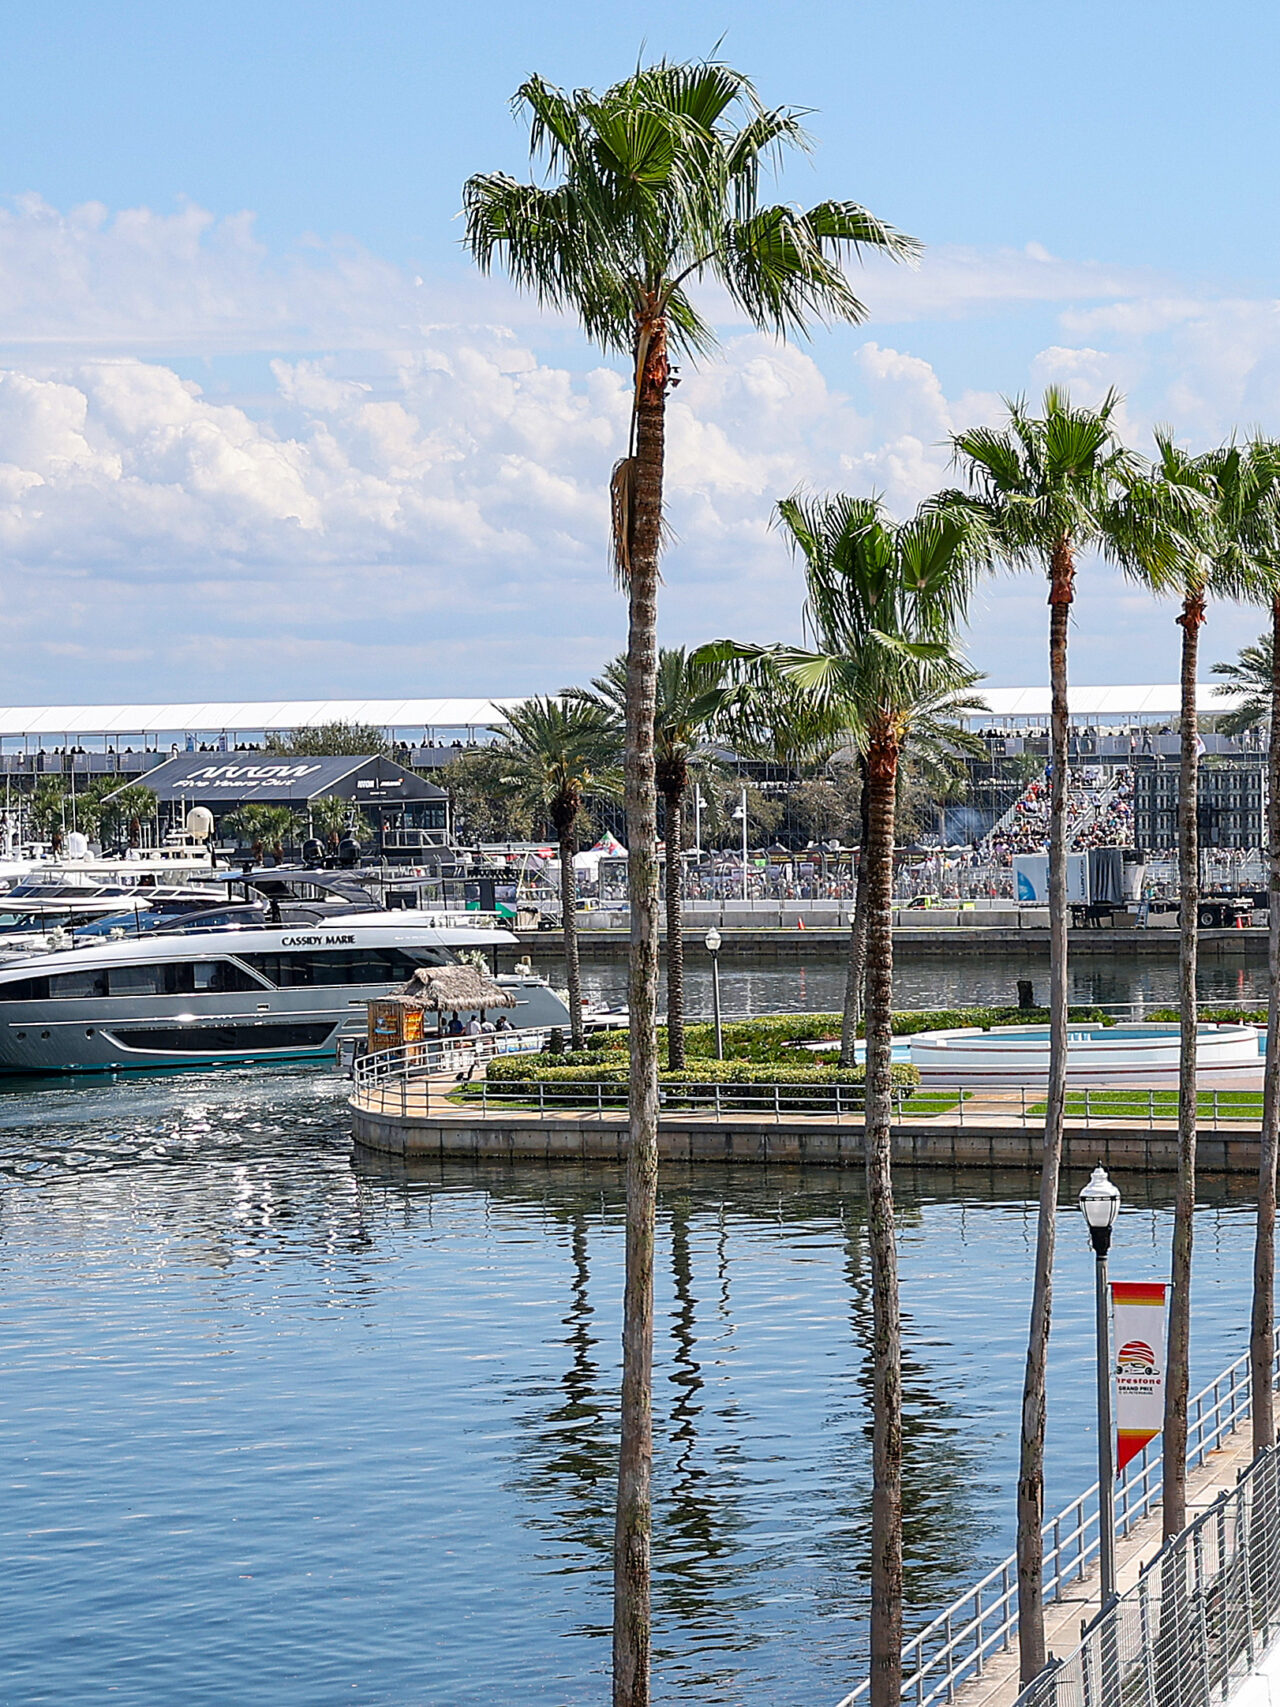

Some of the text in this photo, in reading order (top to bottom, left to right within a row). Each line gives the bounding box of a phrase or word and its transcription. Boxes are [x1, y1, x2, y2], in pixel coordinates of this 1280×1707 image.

[187, 765, 322, 778] ARROW
[172, 778, 297, 788] Five Years Out
[281, 935, 356, 946] CASSIDY MARIE
[1116, 1377, 1161, 1385] irestone
